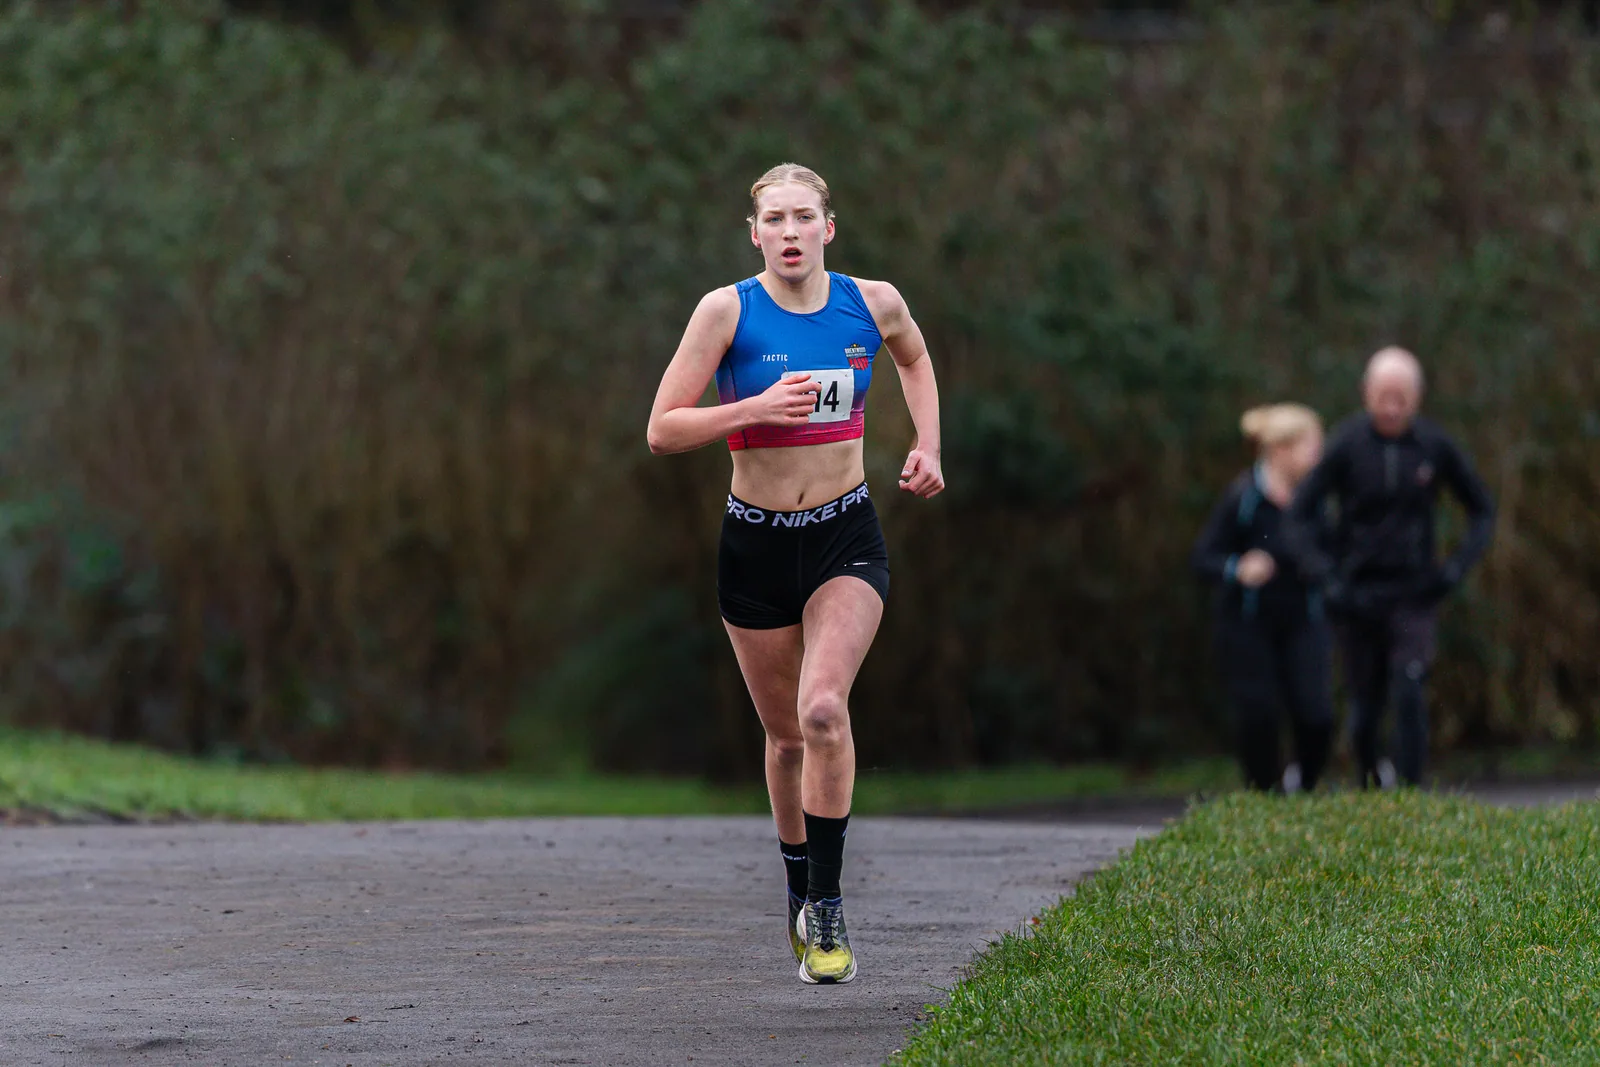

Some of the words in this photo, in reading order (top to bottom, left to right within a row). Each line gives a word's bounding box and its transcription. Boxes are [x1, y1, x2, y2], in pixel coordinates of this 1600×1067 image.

[762, 354, 788, 362] TACTIC
[772, 501, 838, 527] NIKE
[841, 482, 869, 512] PR
